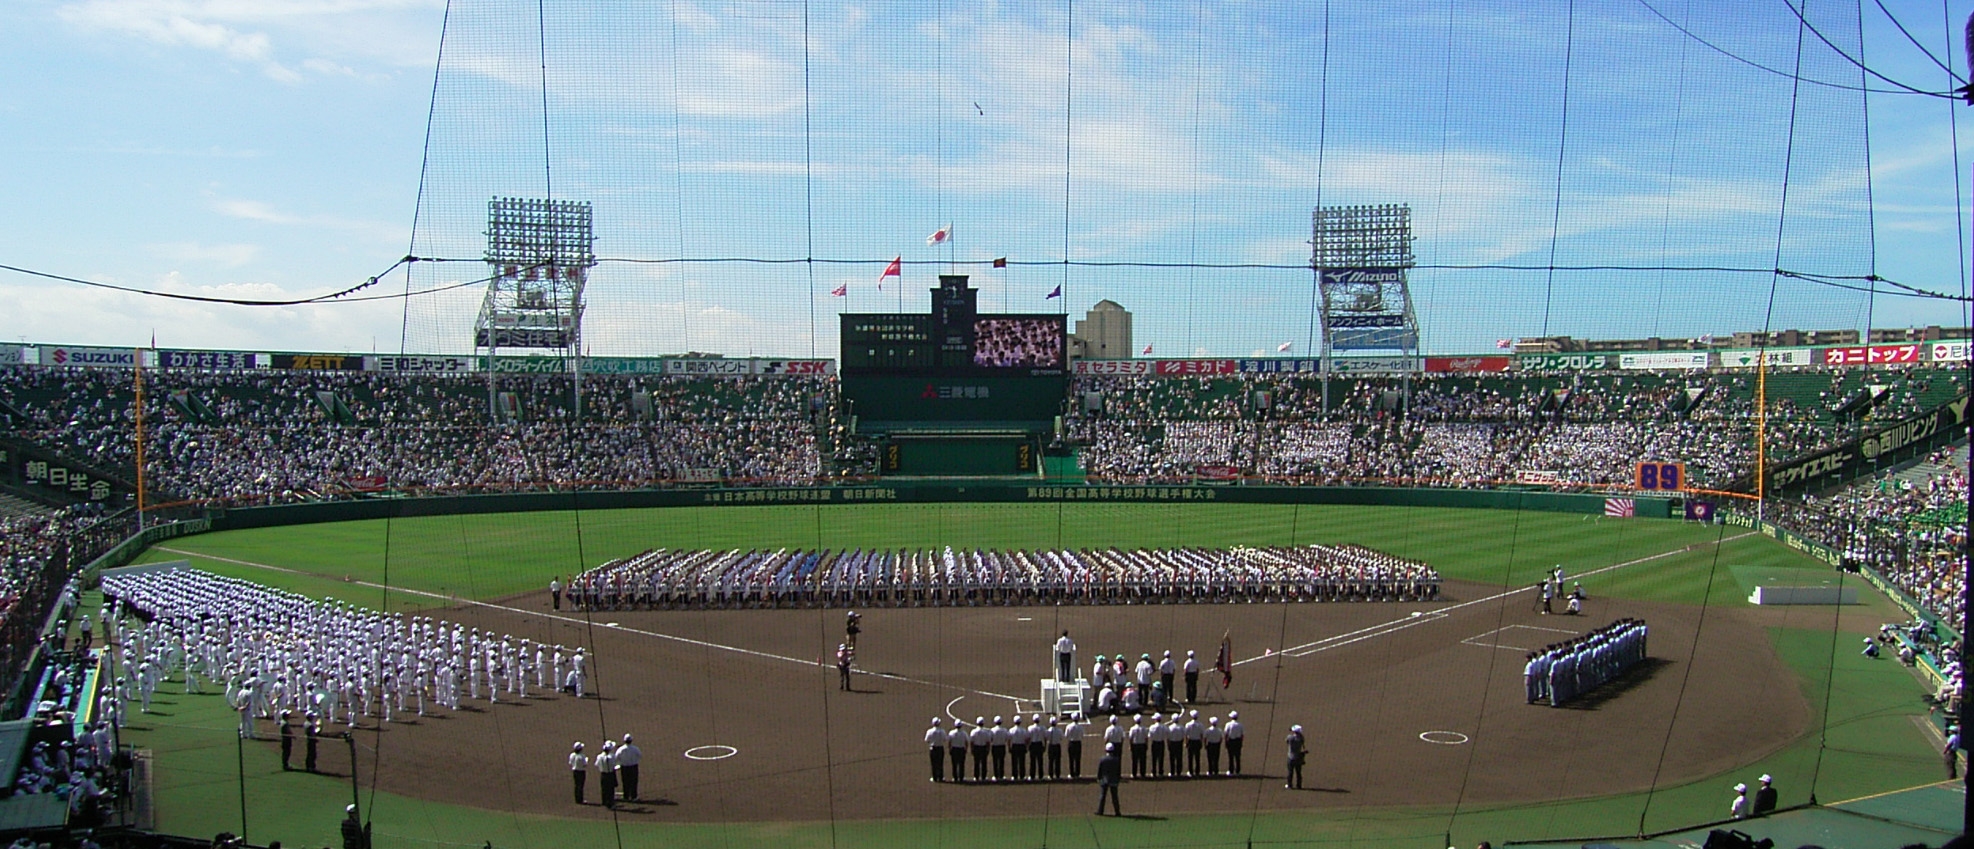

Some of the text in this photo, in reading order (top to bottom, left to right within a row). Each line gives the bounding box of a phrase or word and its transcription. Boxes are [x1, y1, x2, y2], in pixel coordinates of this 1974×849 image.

[71, 353, 134, 364] SUZUKI
[170, 353, 246, 368] わかさ生活
[1827, 346, 1915, 363] カニトップ
[293, 355, 345, 369] ZETT
[380, 357, 466, 371] 三和シャッター
[494, 358, 563, 373] メロディーハイム
[686, 362, 747, 373] 関西ペイント
[785, 361, 828, 373] SSK
[1075, 361, 1148, 373] 京セラミタ
[1186, 361, 1226, 373] ミカド
[1522, 355, 1607, 369] サン・クロレラ
[1880, 411, 1938, 455] 西川リビング
[1786, 451, 1853, 484] ケイエスピー
[25, 460, 110, 500] 朝日生命
[1640, 464, 1678, 490] 89
[724, 490, 831, 502] 日本高等学校野球連盟
[843, 489, 896, 500] 朝日新聞社
[1027, 487, 1216, 499] 第89回全国高等学校野球選手権大会
